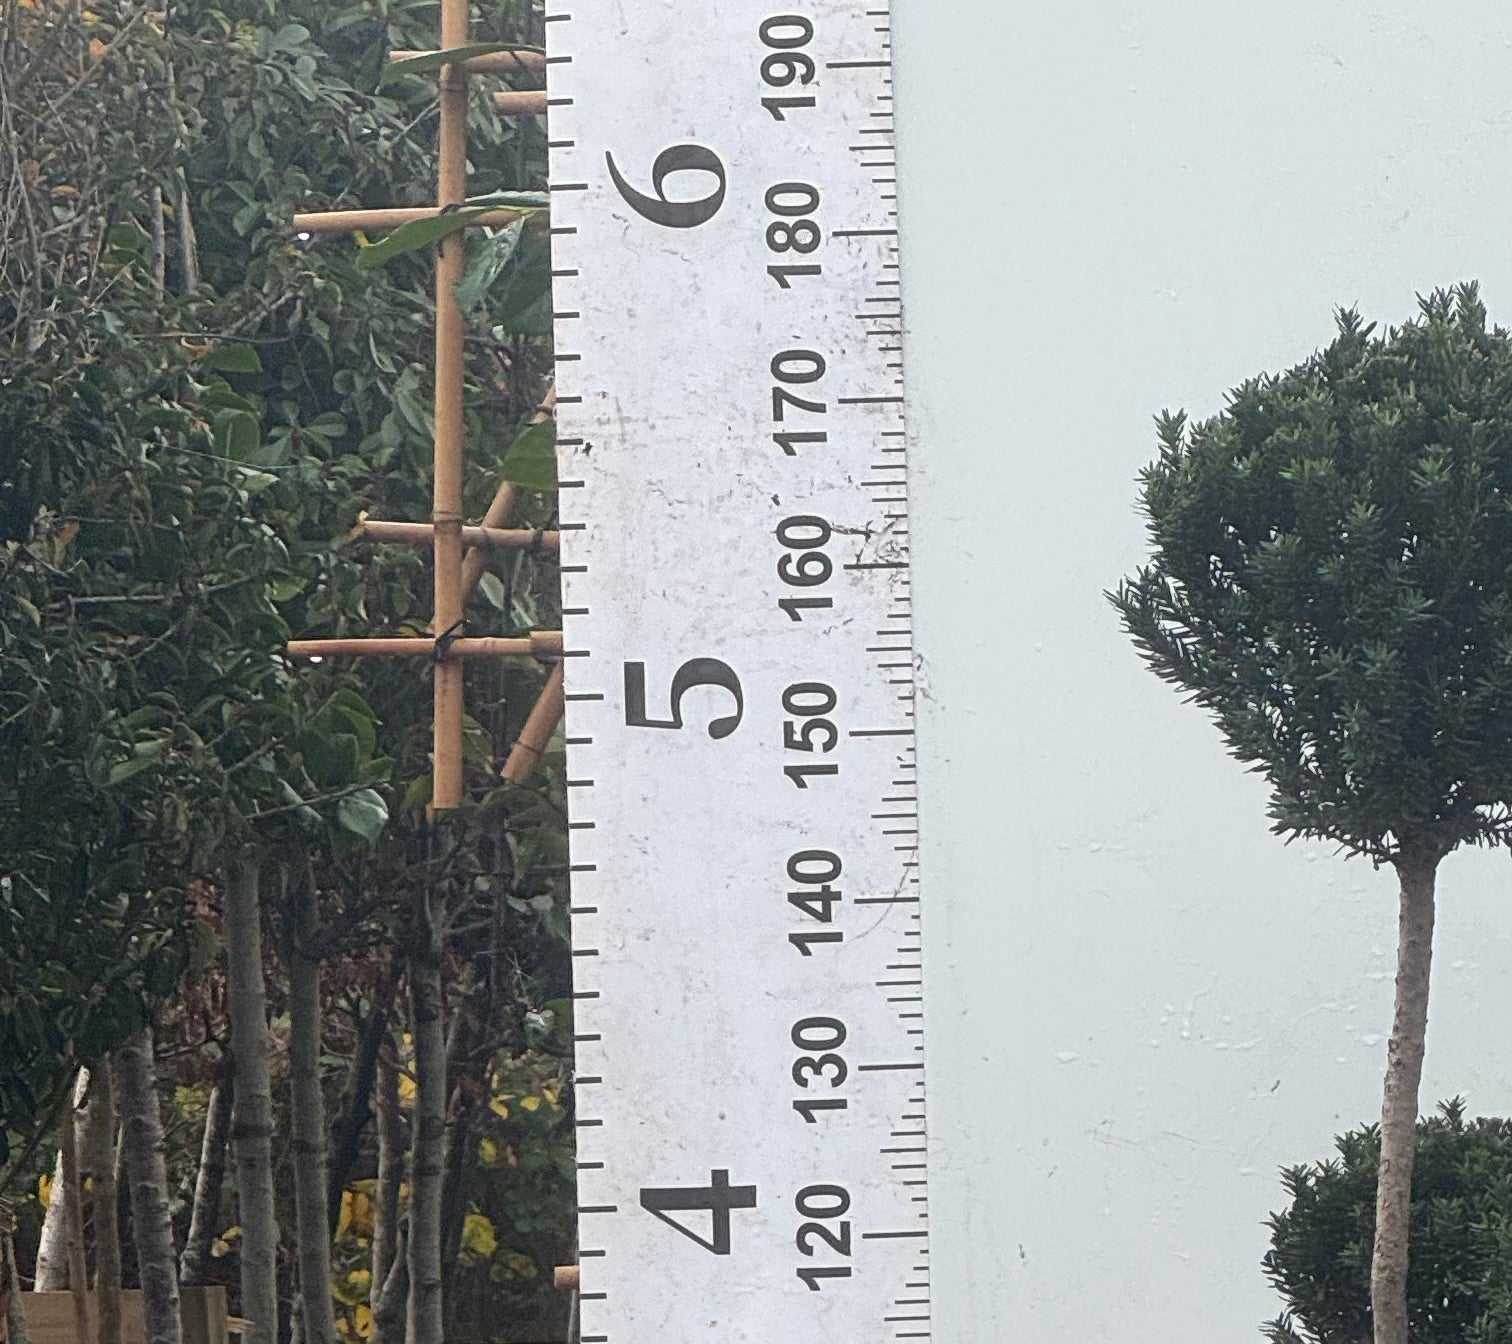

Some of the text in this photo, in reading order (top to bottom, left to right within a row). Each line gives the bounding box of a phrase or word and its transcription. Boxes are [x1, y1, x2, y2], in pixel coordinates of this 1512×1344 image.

[758, 15, 816, 121] 190
[605, 144, 726, 229] 6
[764, 182, 822, 289] 180
[770, 349, 828, 456] 170
[773, 515, 833, 622] 160
[623, 657, 744, 740] 5
[781, 682, 839, 789] 150
[786, 849, 844, 957] 140
[791, 1016, 848, 1124] 130
[639, 1169, 757, 1256] 4
[795, 1184, 852, 1292] 120
